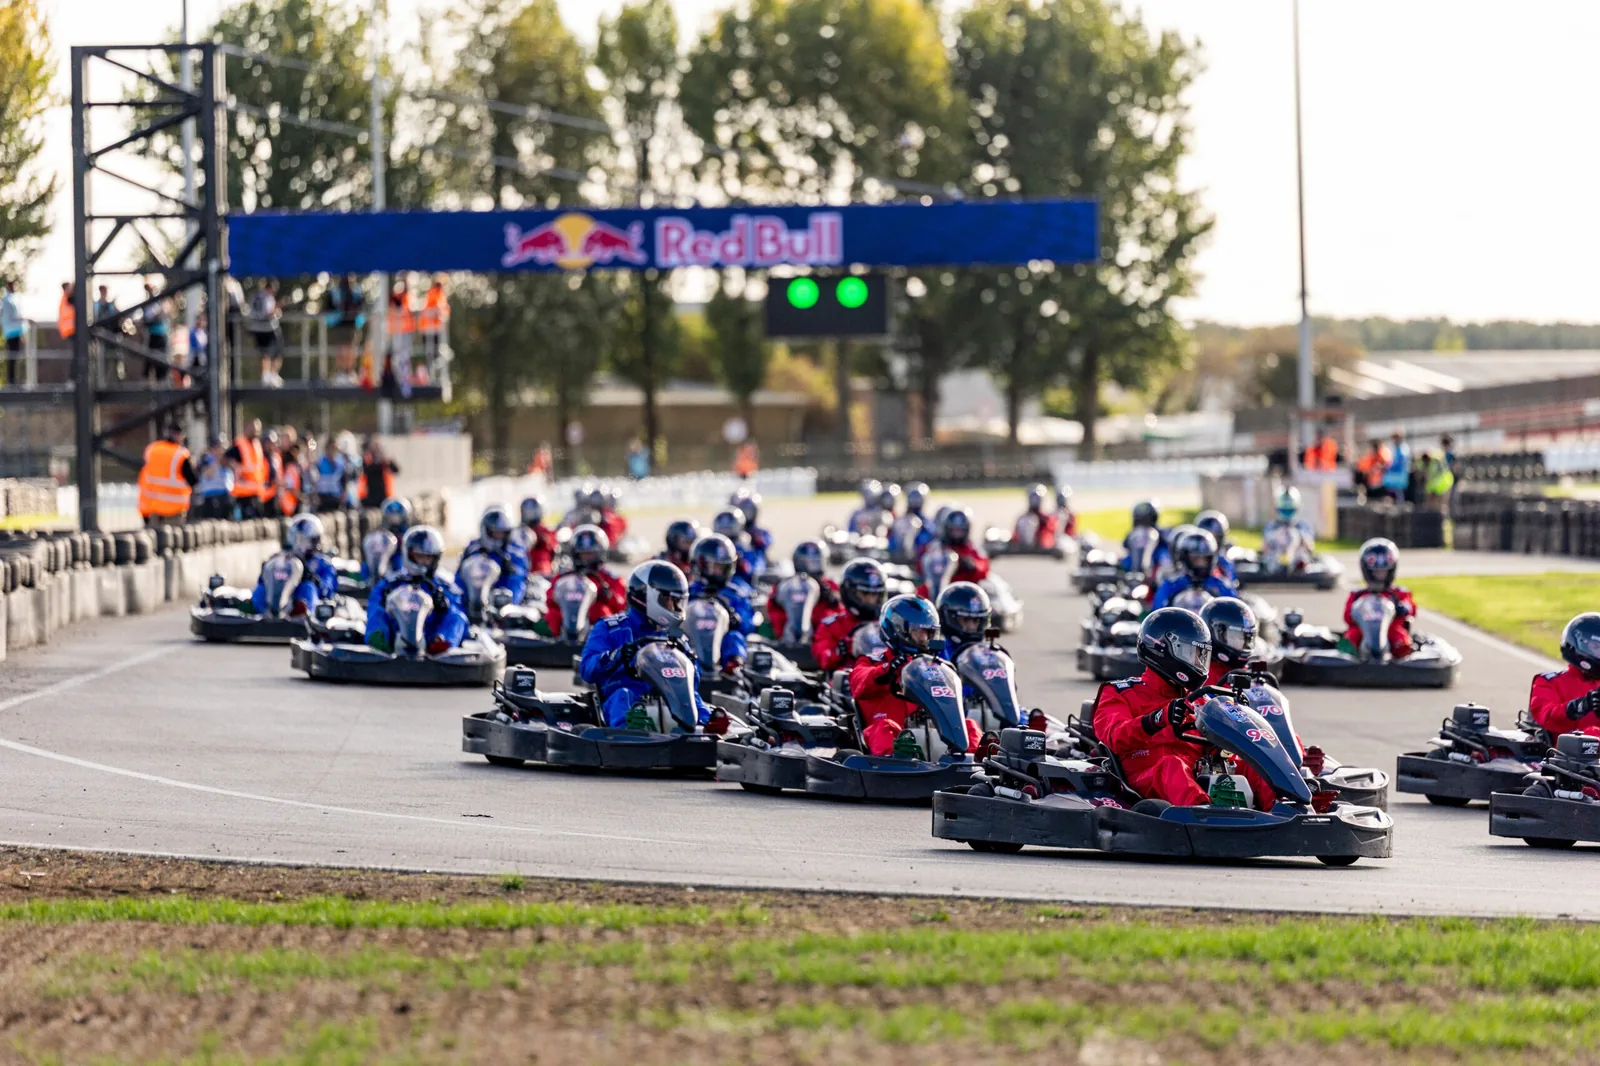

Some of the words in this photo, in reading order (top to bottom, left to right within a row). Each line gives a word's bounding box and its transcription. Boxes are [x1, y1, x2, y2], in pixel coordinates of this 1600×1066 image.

[655, 214, 749, 266] Red
[753, 212, 843, 266] Bull
[983, 668, 1007, 679] 94
[931, 685, 956, 697] 52
[1257, 705, 1284, 716] 70
[1246, 729, 1276, 742] 98
